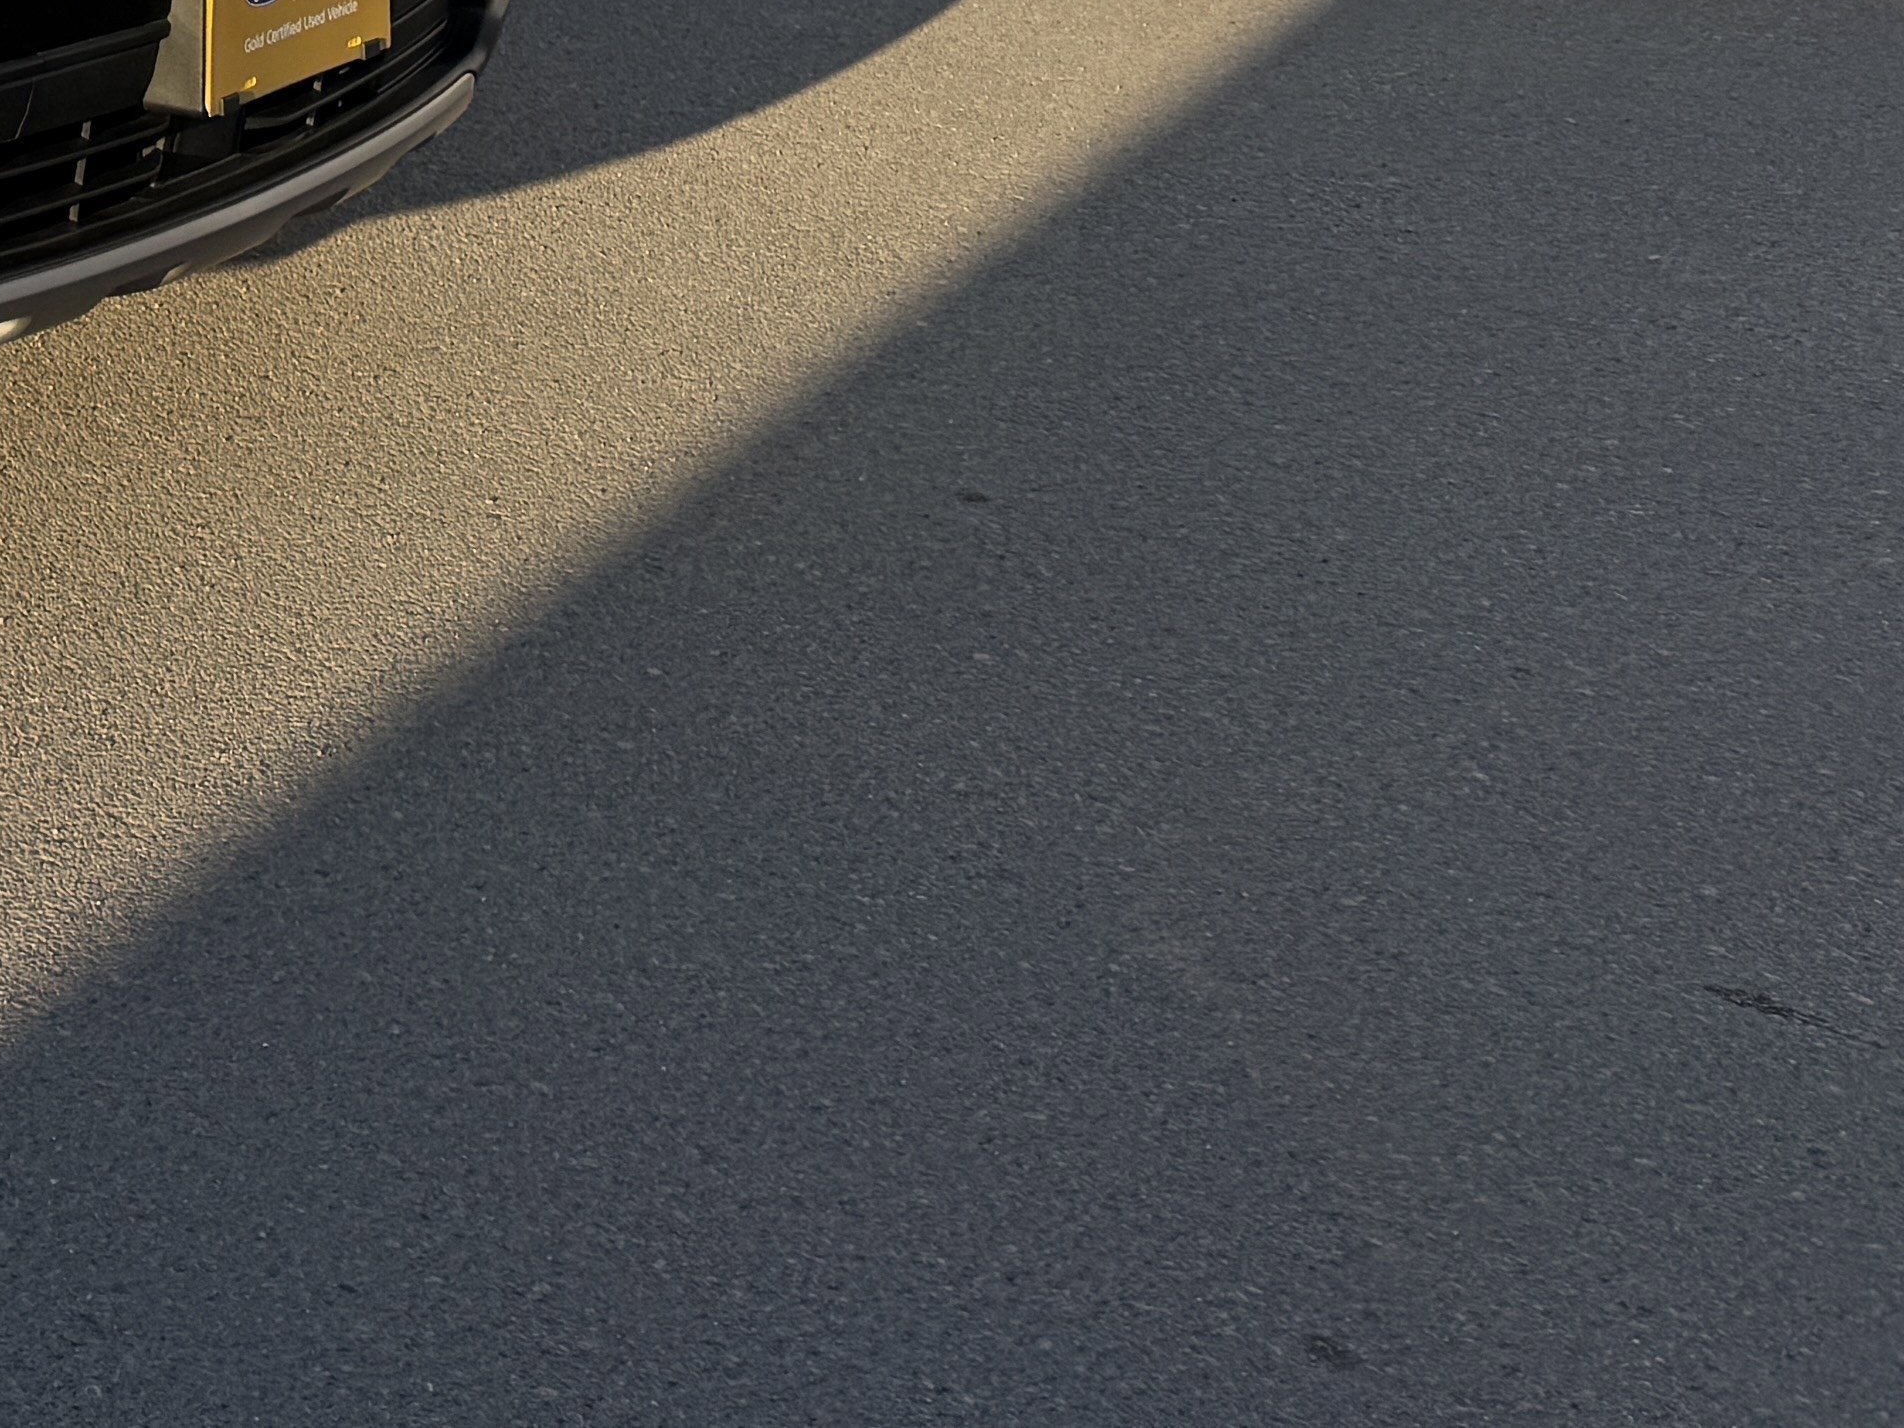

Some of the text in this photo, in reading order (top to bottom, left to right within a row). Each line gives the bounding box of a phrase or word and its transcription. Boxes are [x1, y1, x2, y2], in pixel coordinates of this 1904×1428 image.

[244, 0, 359, 54] Gold Certified Used Vehicle
